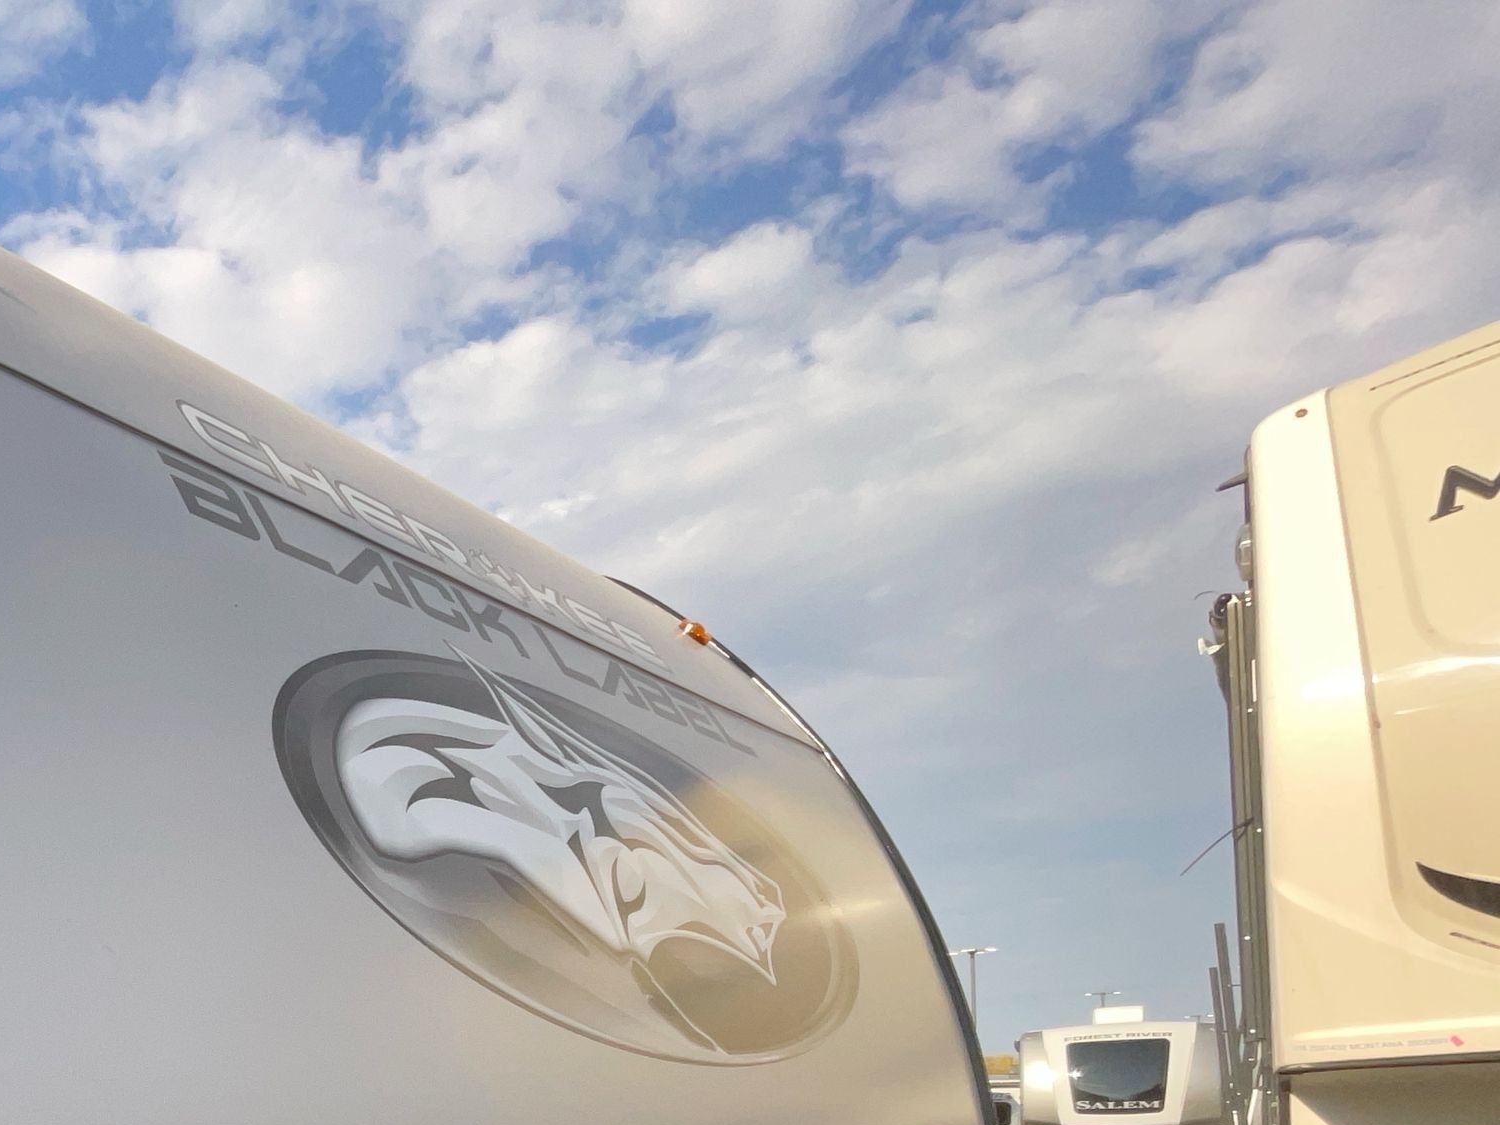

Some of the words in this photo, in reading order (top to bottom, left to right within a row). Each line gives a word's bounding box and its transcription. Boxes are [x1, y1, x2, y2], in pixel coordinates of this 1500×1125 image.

[157, 449, 531, 659] BLACK
[531, 622, 757, 758] LABEL
[1064, 1033, 1122, 1042] FOREST
[1076, 1100, 1161, 1110] SALEM
